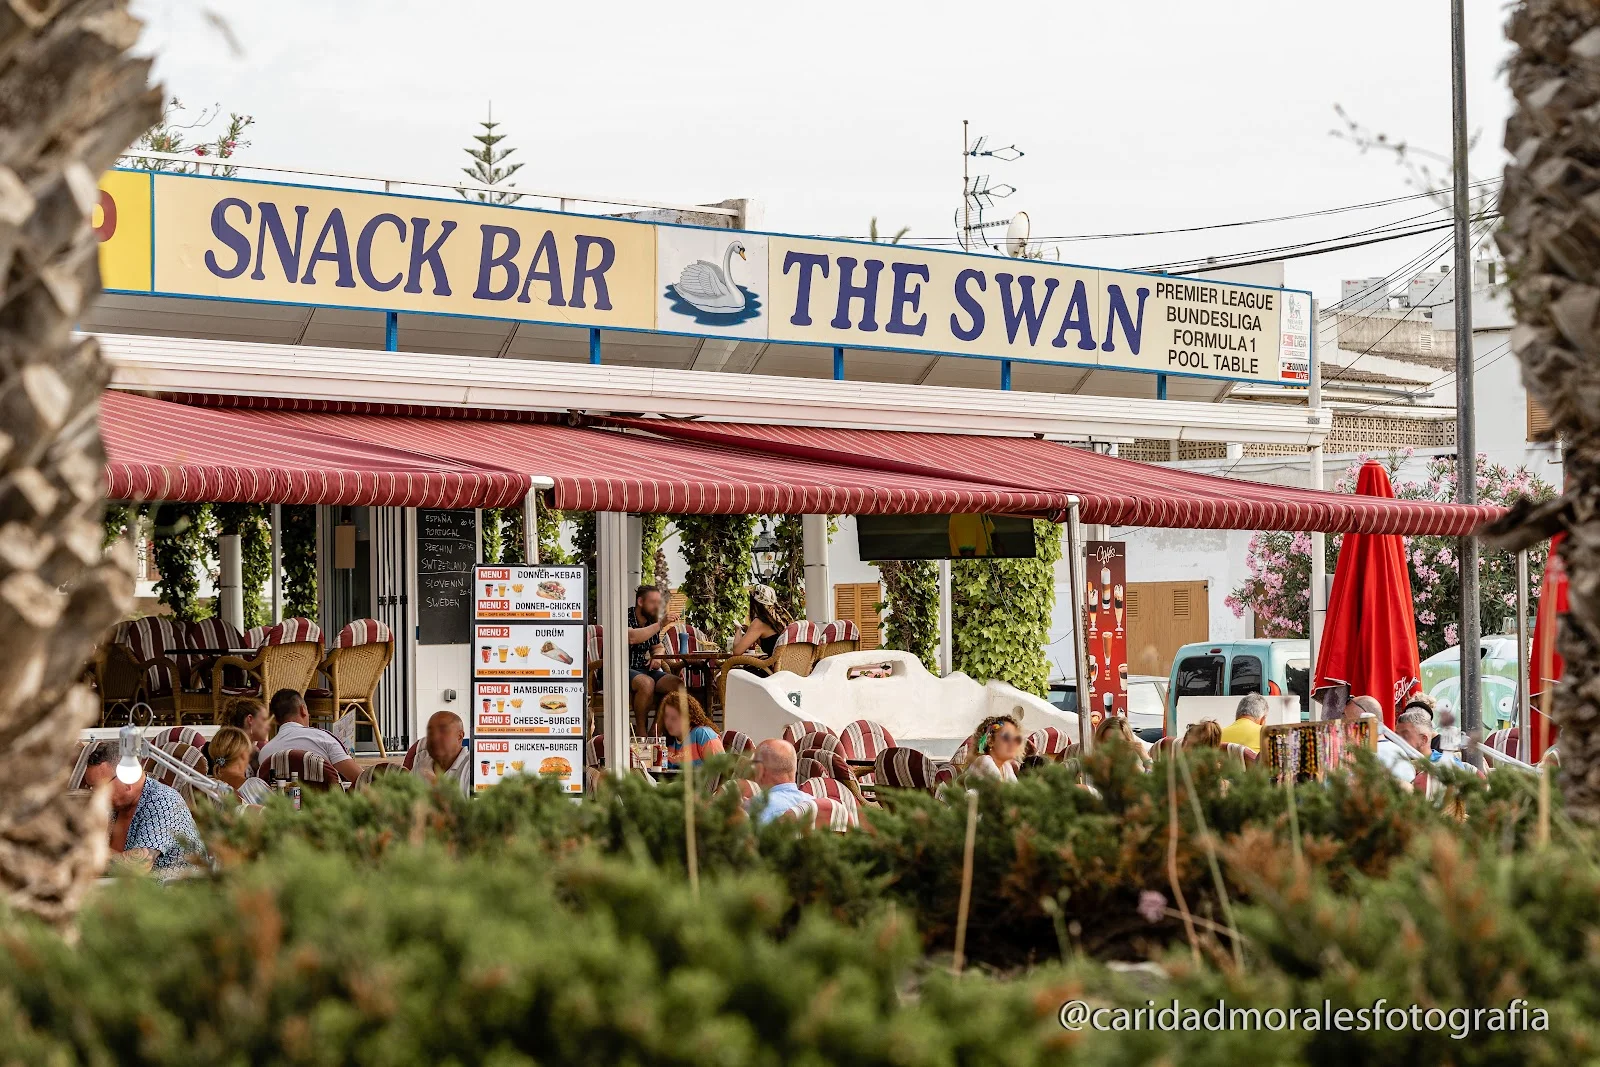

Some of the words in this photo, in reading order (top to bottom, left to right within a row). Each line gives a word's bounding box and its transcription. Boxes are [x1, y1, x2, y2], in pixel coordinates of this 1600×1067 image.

[204, 197, 457, 296] SNACK
[473, 224, 616, 311] BAR
[1156, 282, 1218, 304] PREMIER
[1222, 289, 1273, 311] LEAGUE
[782, 250, 931, 337] THE
[950, 268, 1150, 356] SWAN
[1166, 306, 1262, 331] BUNDESLIGA
[1173, 329, 1247, 352] FORMULA
[1250, 337, 1256, 353] 1
[1168, 350, 1209, 369] POOL
[1213, 354, 1259, 374] TABLE
[1295, 372, 1309, 380] LIVE
[425, 513, 453, 524] ESPAÑA
[425, 528, 460, 537] PORTUGAL
[480, 569, 502, 579] MENU
[517, 570, 582, 579] DONNER-KEBAB
[426, 597, 460, 608] SWEDEN
[480, 601, 502, 609] MENU
[503, 601, 509, 609] 3
[515, 602, 581, 610] DONNER-CHICKEN
[479, 628, 501, 636] MENU
[503, 628, 509, 636] 2
[535, 629, 564, 637] DURÜM
[513, 686, 564, 694] HAMBURGER
[481, 716, 503, 724] MENU
[504, 716, 510, 724] 5
[513, 717, 581, 725] CHEESE-BURGER
[478, 743, 501, 751] MENU
[502, 743, 508, 751] 6
[514, 743, 578, 751] CHICKEN-BURGER
